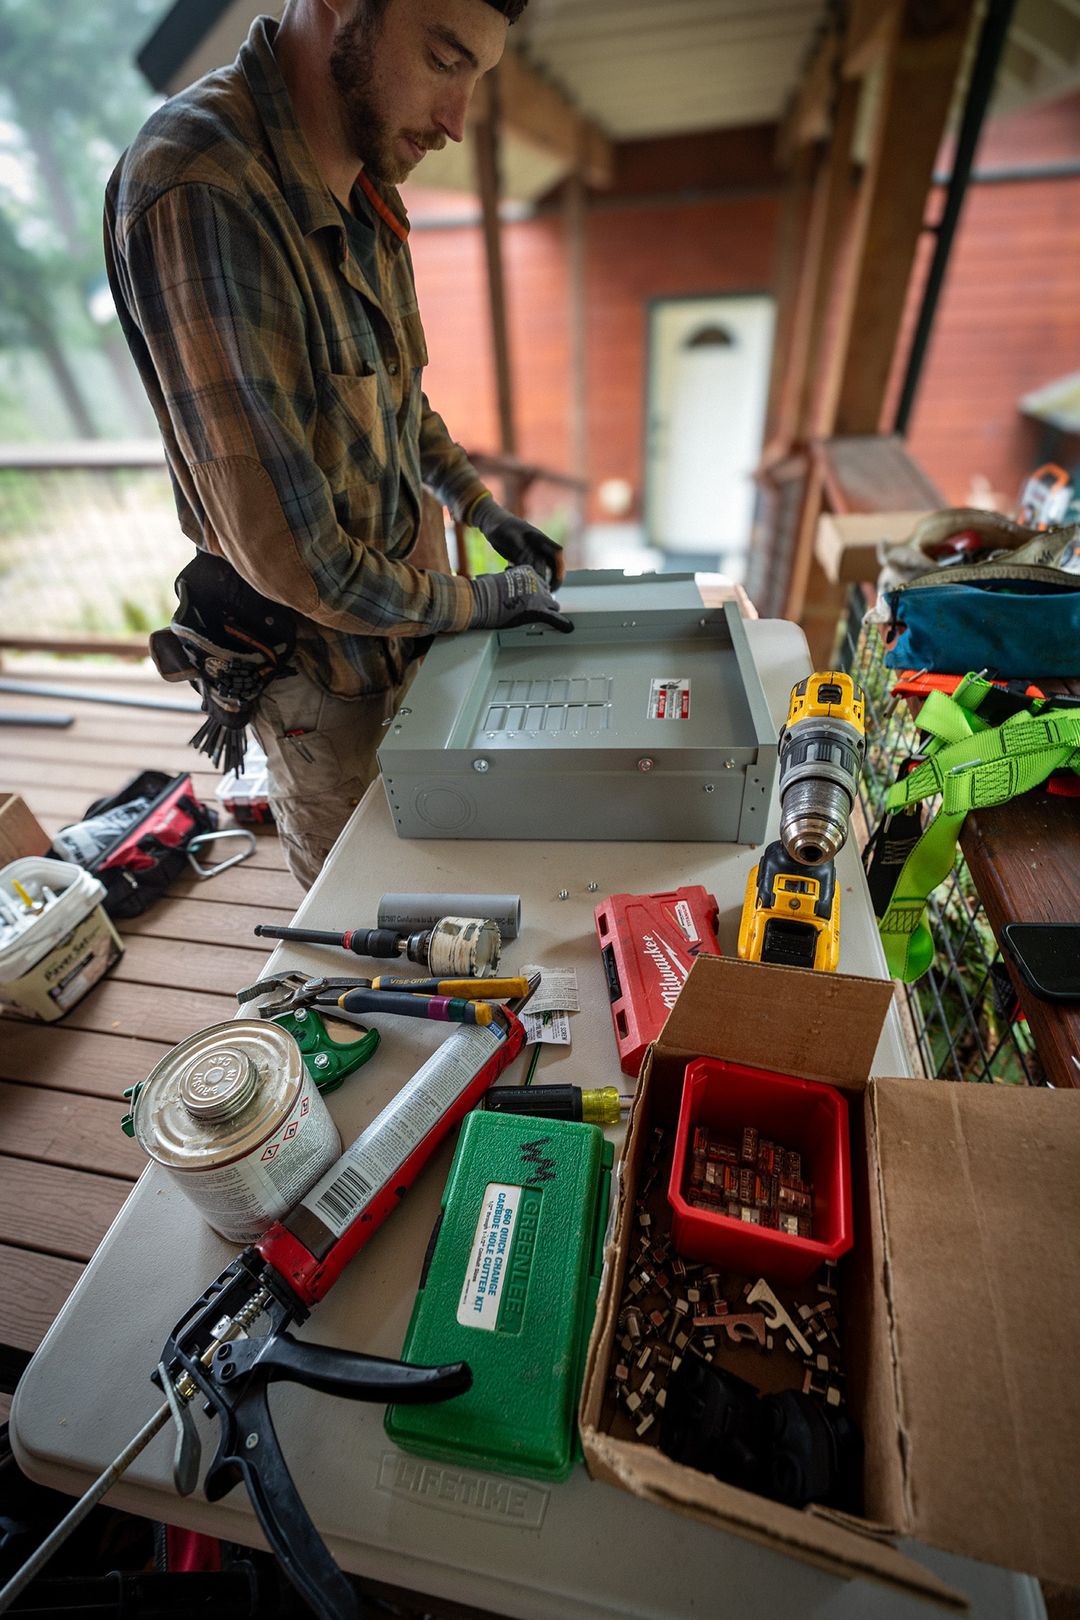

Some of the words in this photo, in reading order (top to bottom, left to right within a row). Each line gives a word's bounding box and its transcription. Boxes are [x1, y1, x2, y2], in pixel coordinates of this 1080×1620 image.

[642, 934, 682, 1009] Milwaukee
[492, 1192, 506, 1229] CARBIDE
[503, 1208, 513, 1225] 660
[486, 1231, 498, 1255] HOLE
[496, 1227, 509, 1255] QUICK
[505, 1199, 538, 1312] GREENLEE
[477, 1257, 492, 1293] CUTTER
[488, 1257, 503, 1296] CHANGE
[473, 1295, 484, 1313] KIT
[396, 1462, 528, 1518] LIFETIME
